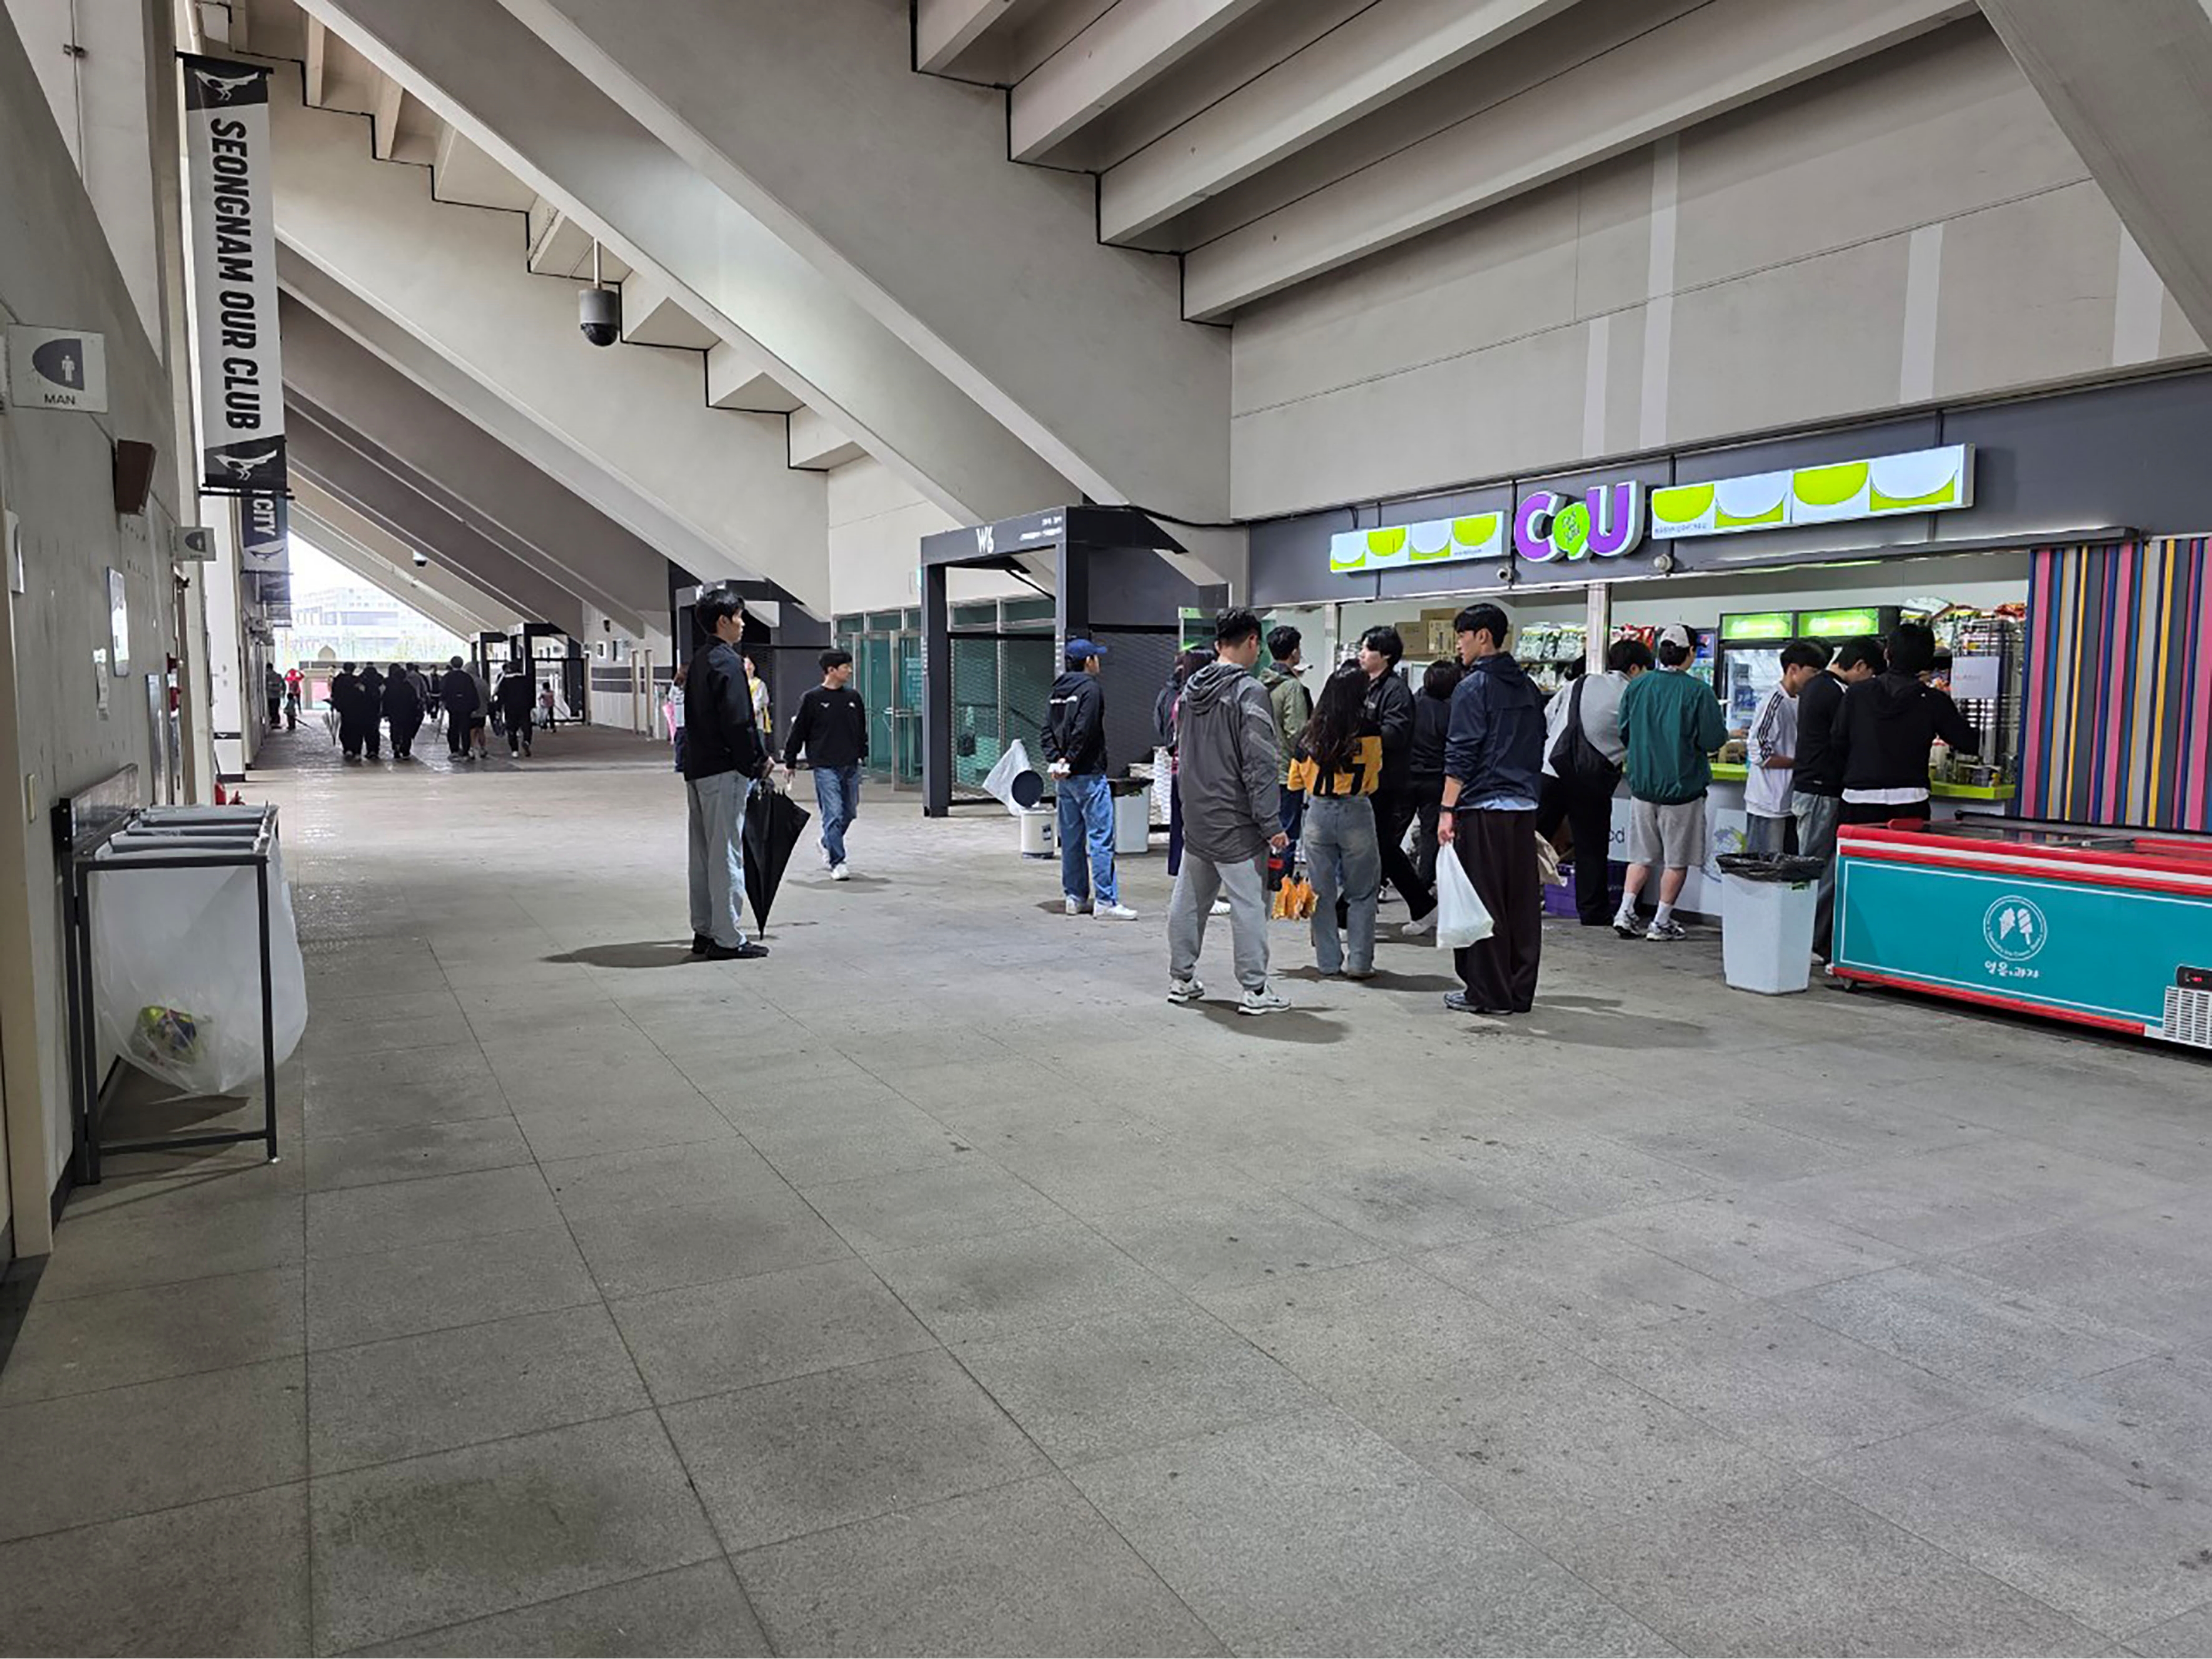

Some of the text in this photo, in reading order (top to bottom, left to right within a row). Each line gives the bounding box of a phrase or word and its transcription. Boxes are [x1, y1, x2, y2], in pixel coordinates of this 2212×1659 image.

[211, 118, 261, 429] SEONGNAM OUR CLUB
[44, 394, 75, 405] MAN
[253, 499, 275, 536] CITY
[1514, 481, 1638, 562] CU
[976, 526, 994, 553] W6
